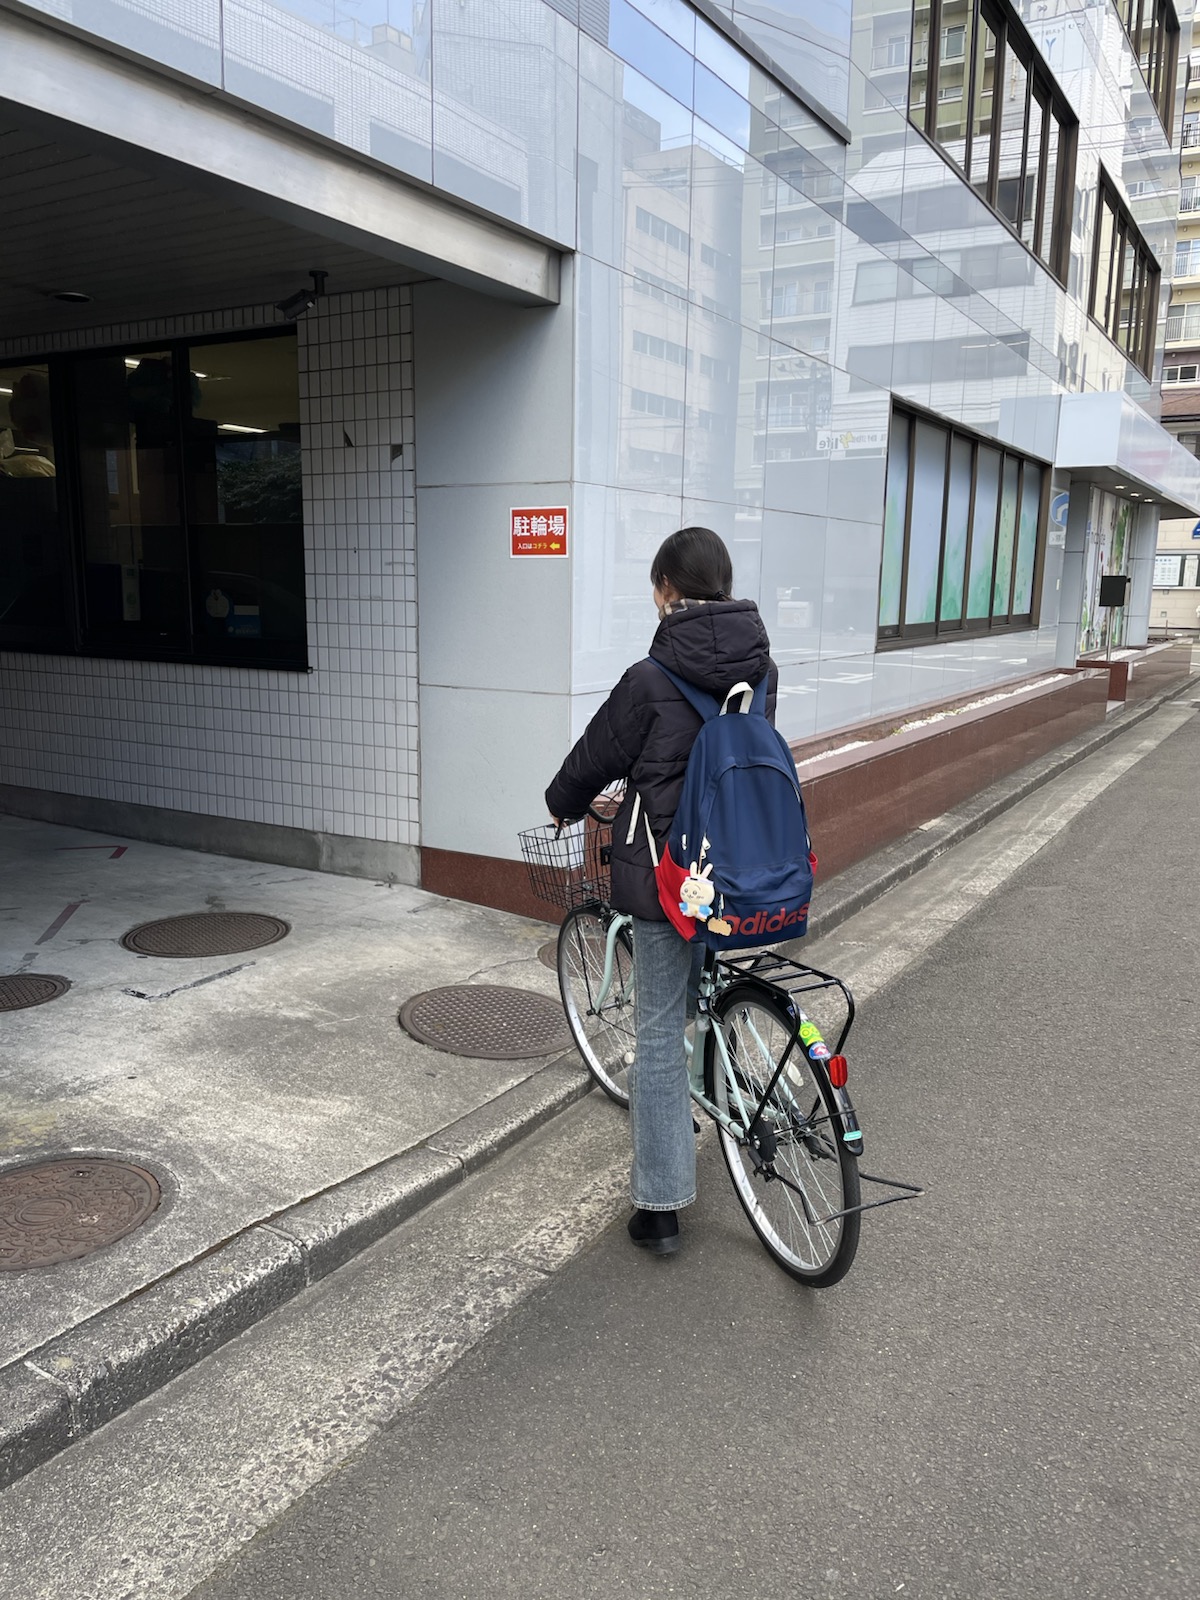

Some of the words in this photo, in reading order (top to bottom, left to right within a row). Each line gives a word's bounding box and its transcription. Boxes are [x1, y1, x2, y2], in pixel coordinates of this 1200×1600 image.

[513, 515, 565, 536] 駐輪場
[517, 542, 548, 550] 入口はコチラ
[721, 902, 810, 936] adidas
